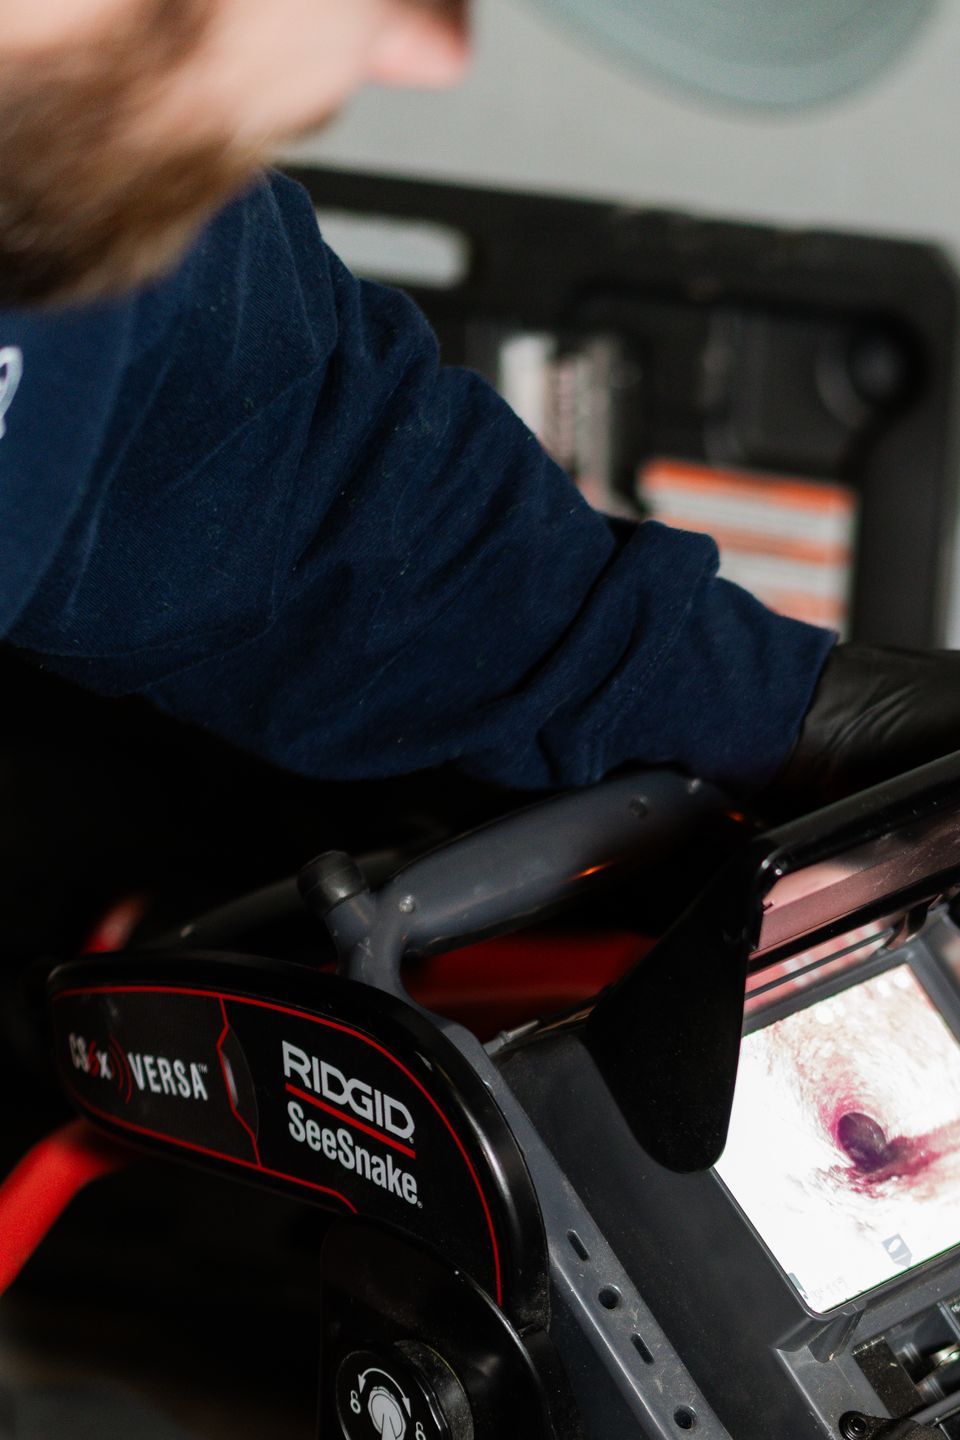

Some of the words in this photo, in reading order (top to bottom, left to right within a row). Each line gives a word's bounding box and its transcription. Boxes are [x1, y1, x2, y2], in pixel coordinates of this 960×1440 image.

[127, 1051, 208, 1101] VERSA
[282, 1040, 415, 1140] RIDGID
[287, 1101, 419, 1205] SeeSnake
